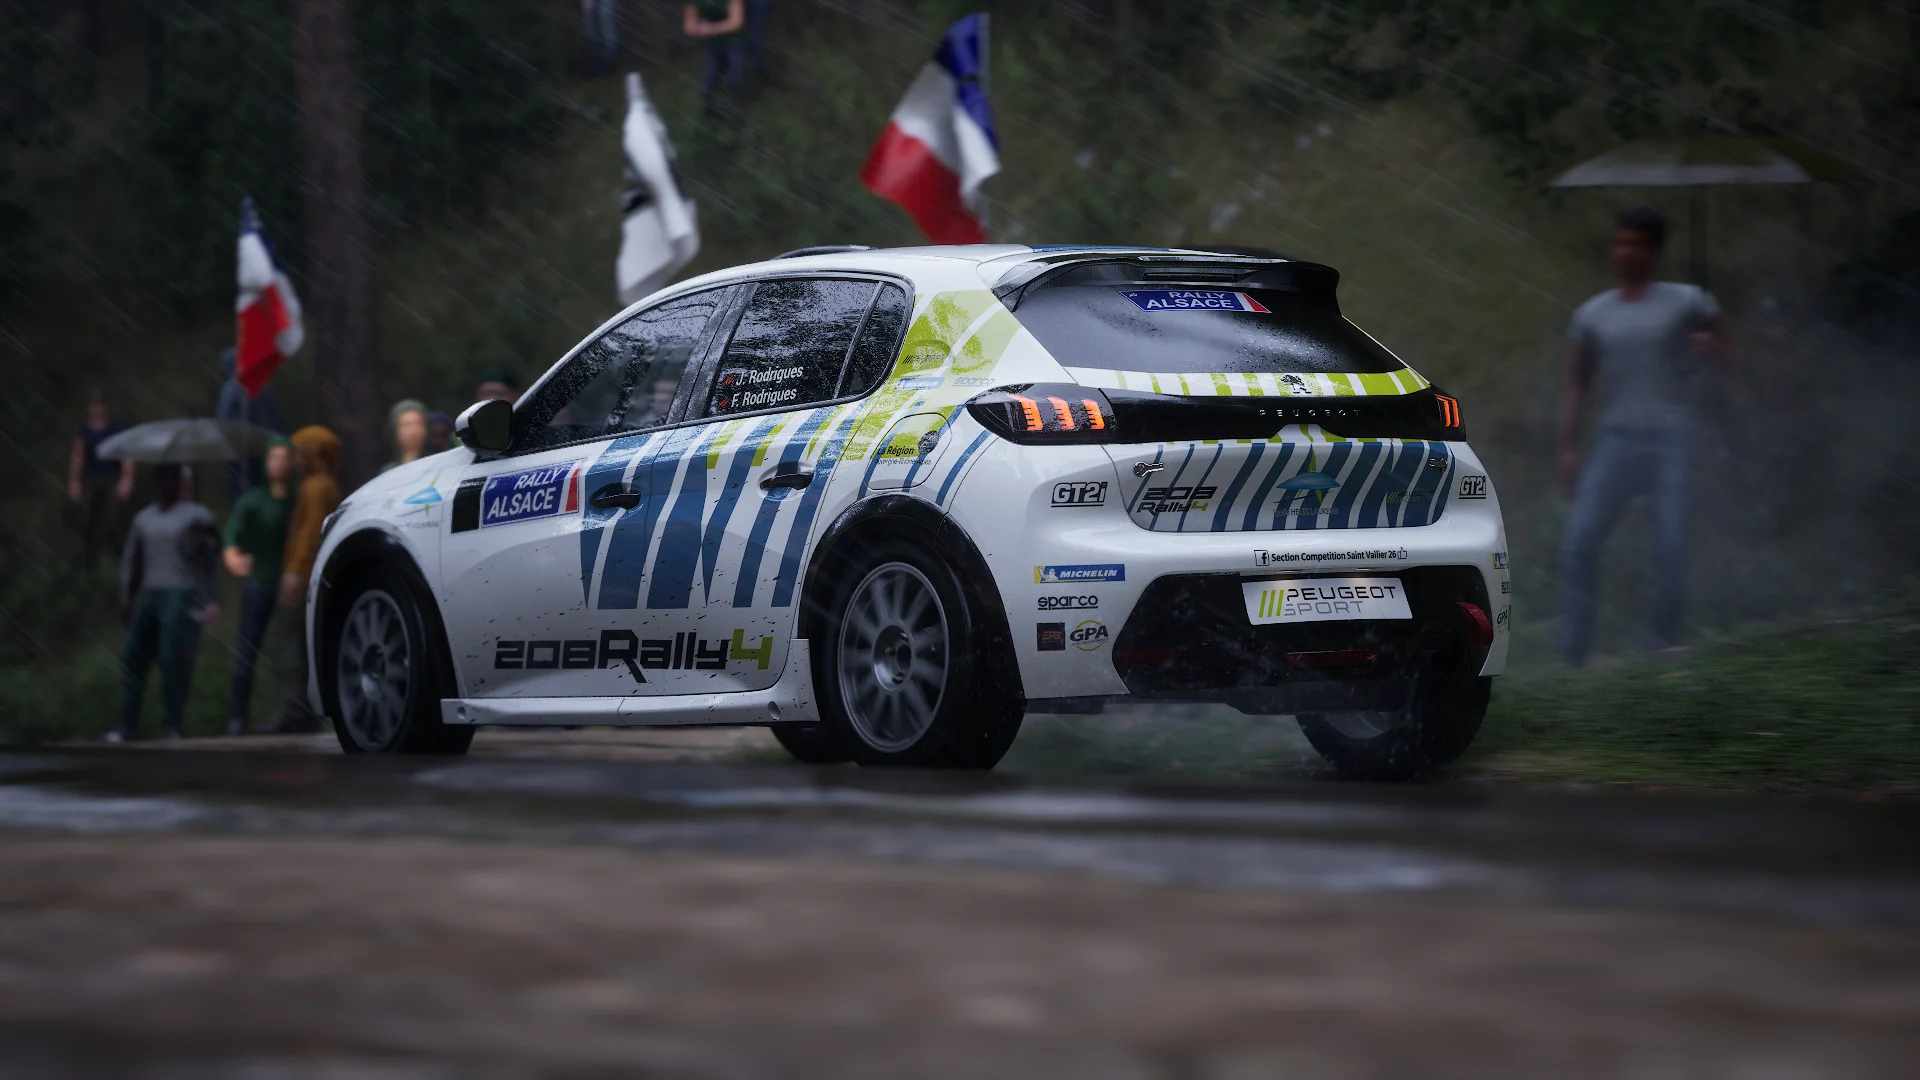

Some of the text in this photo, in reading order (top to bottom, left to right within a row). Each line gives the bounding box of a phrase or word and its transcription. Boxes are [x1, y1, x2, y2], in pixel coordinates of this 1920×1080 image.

[1167, 291, 1226, 299] RALLY
[1146, 298, 1235, 309] ALSACE
[736, 366, 804, 386] J. Rodrigues
[953, 377, 996, 387] sparco
[731, 387, 798, 408] F. Rodrigues
[1259, 409, 1361, 417] PEUGEOT
[886, 445, 915, 457] Région
[513, 468, 565, 491] RALLY
[1142, 486, 1218, 500] 208
[486, 487, 557, 520] ALSACE
[1136, 501, 1209, 517] Rally4
[1271, 552, 1300, 562] Section
[1301, 551, 1346, 562] Competition
[1347, 550, 1365, 560] Saint
[1366, 550, 1388, 559] Vallier
[1388, 550, 1397, 559] 26
[1059, 569, 1119, 578] MICHELIN
[1286, 586, 1396, 601] PEUGEOT
[1038, 595, 1098, 611] sparco
[1284, 601, 1364, 616] SPORT
[1069, 625, 1109, 642] GPA
